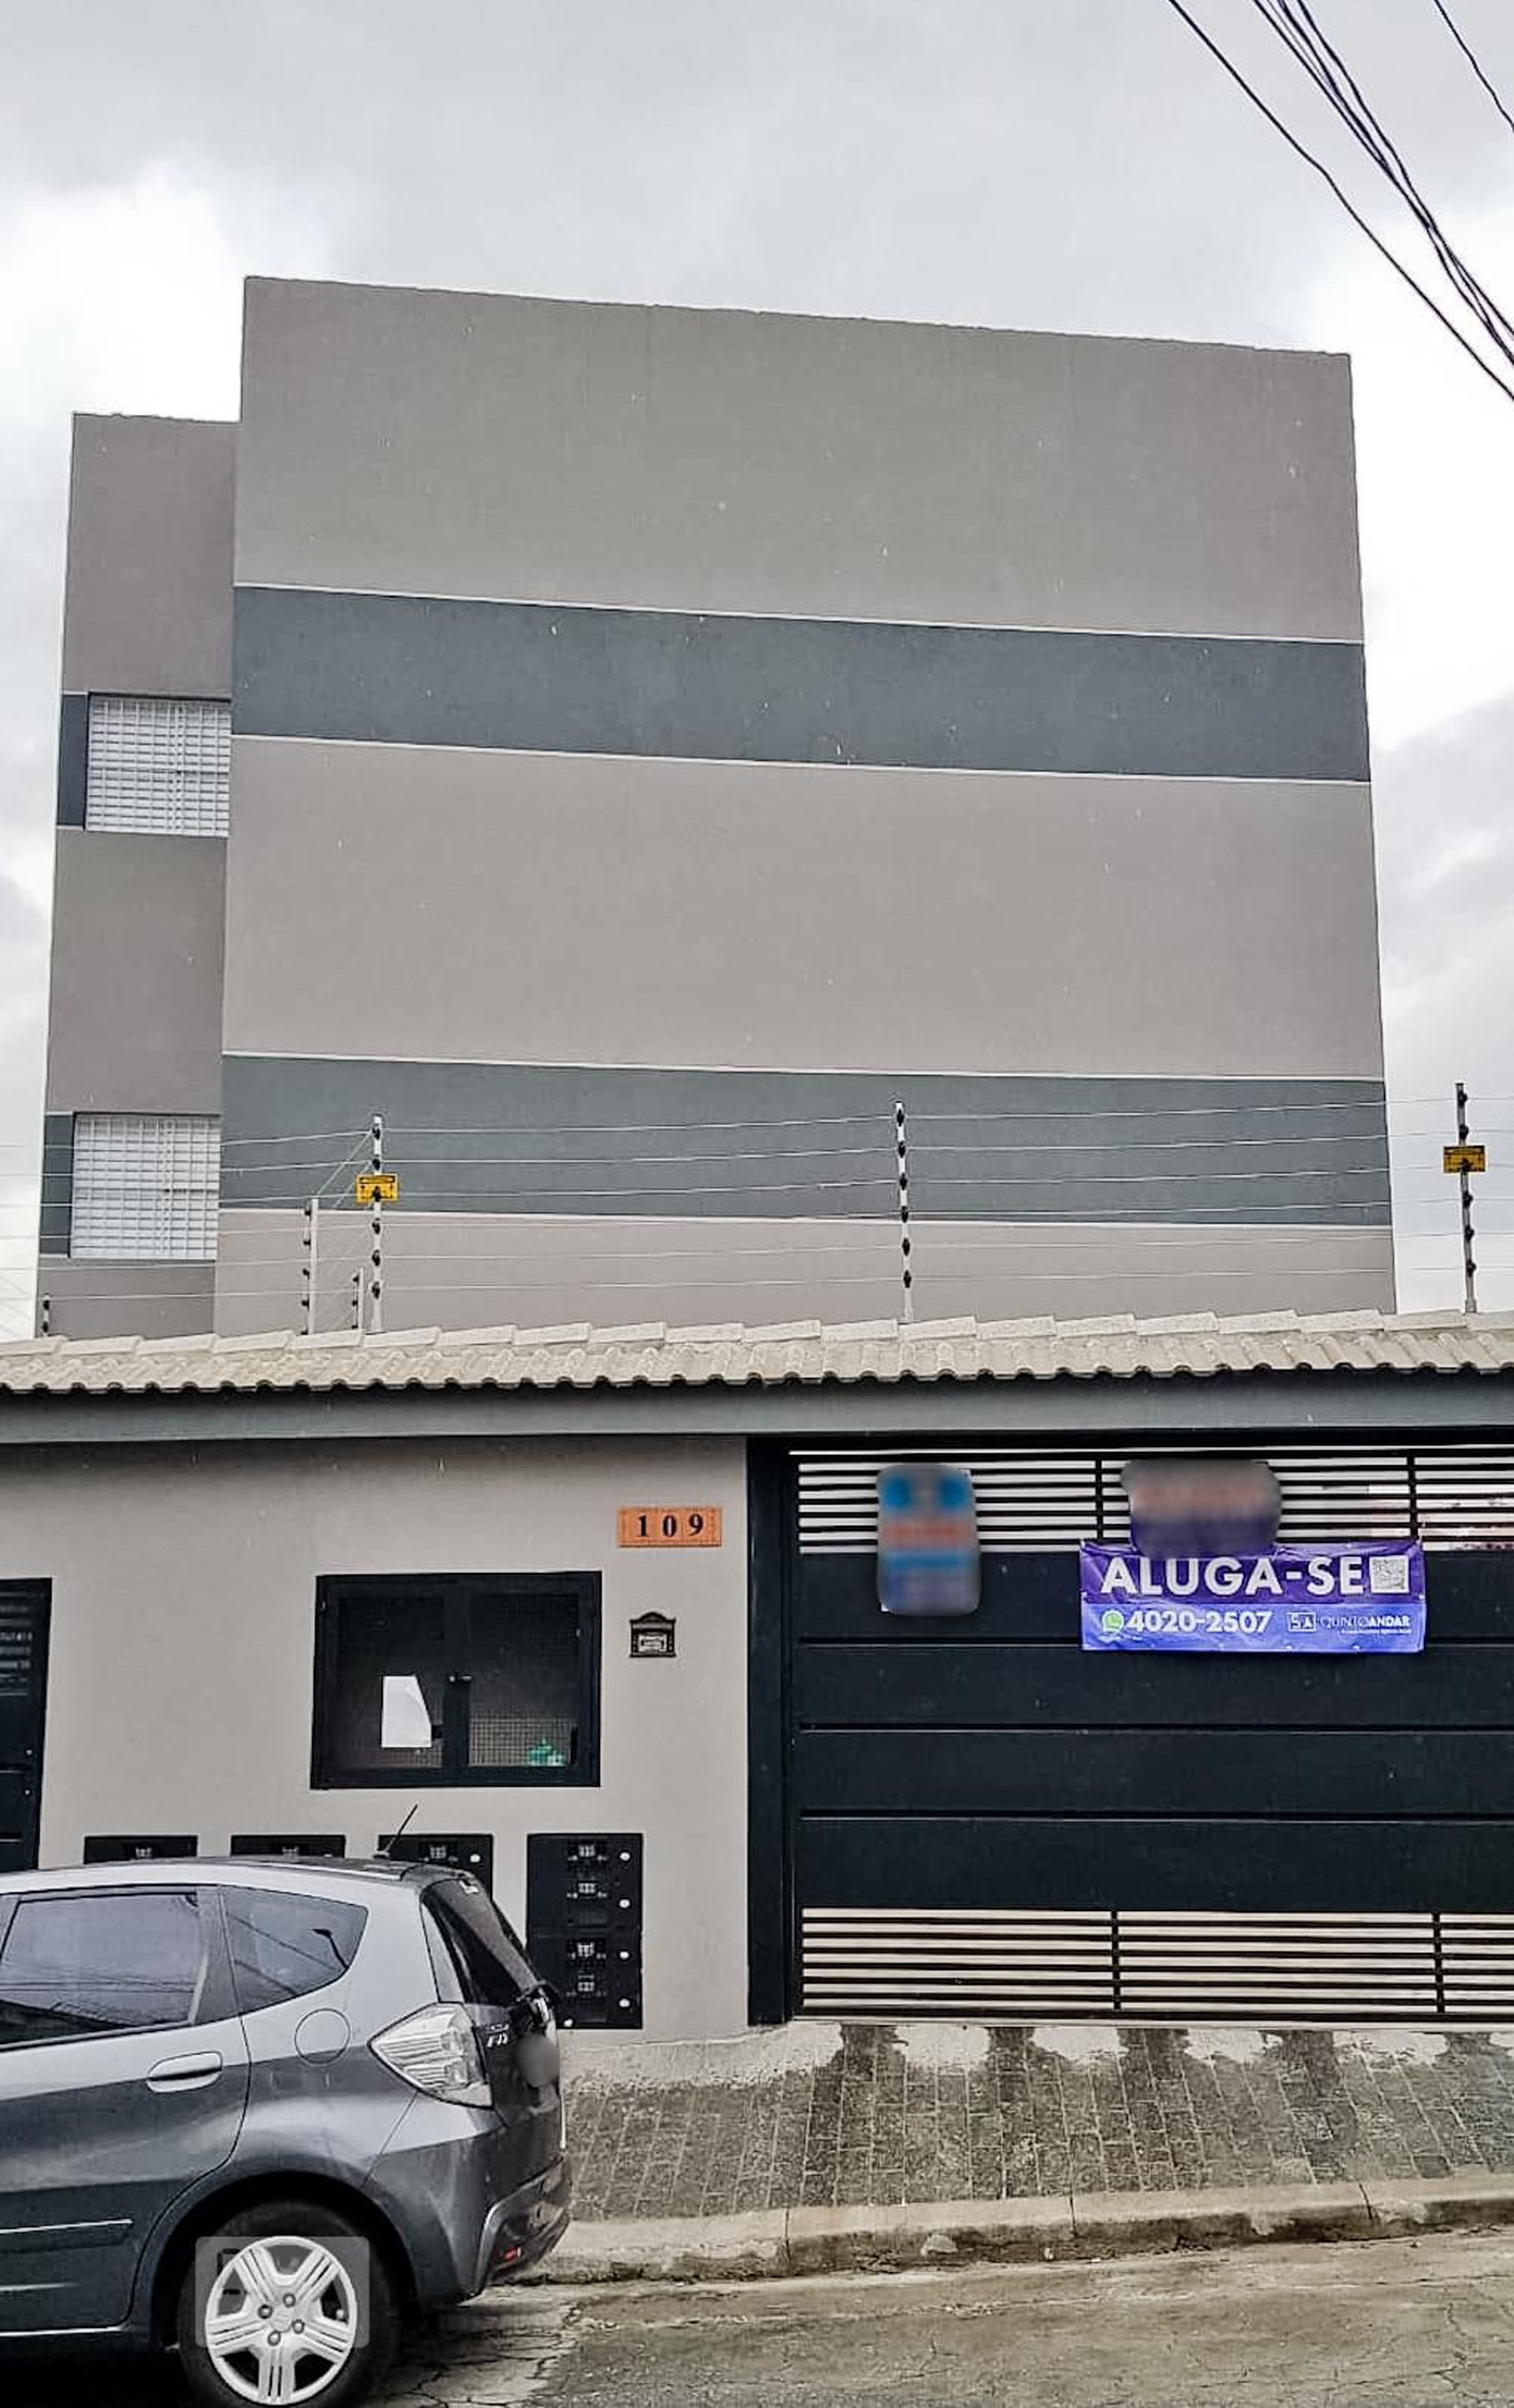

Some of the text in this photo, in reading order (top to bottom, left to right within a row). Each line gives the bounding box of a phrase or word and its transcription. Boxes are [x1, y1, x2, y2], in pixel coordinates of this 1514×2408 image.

[638, 1513, 704, 1538] 109
[1100, 1556, 1365, 1596] ALUGA-SE
[1124, 1610, 1273, 1633] 4020-2507
